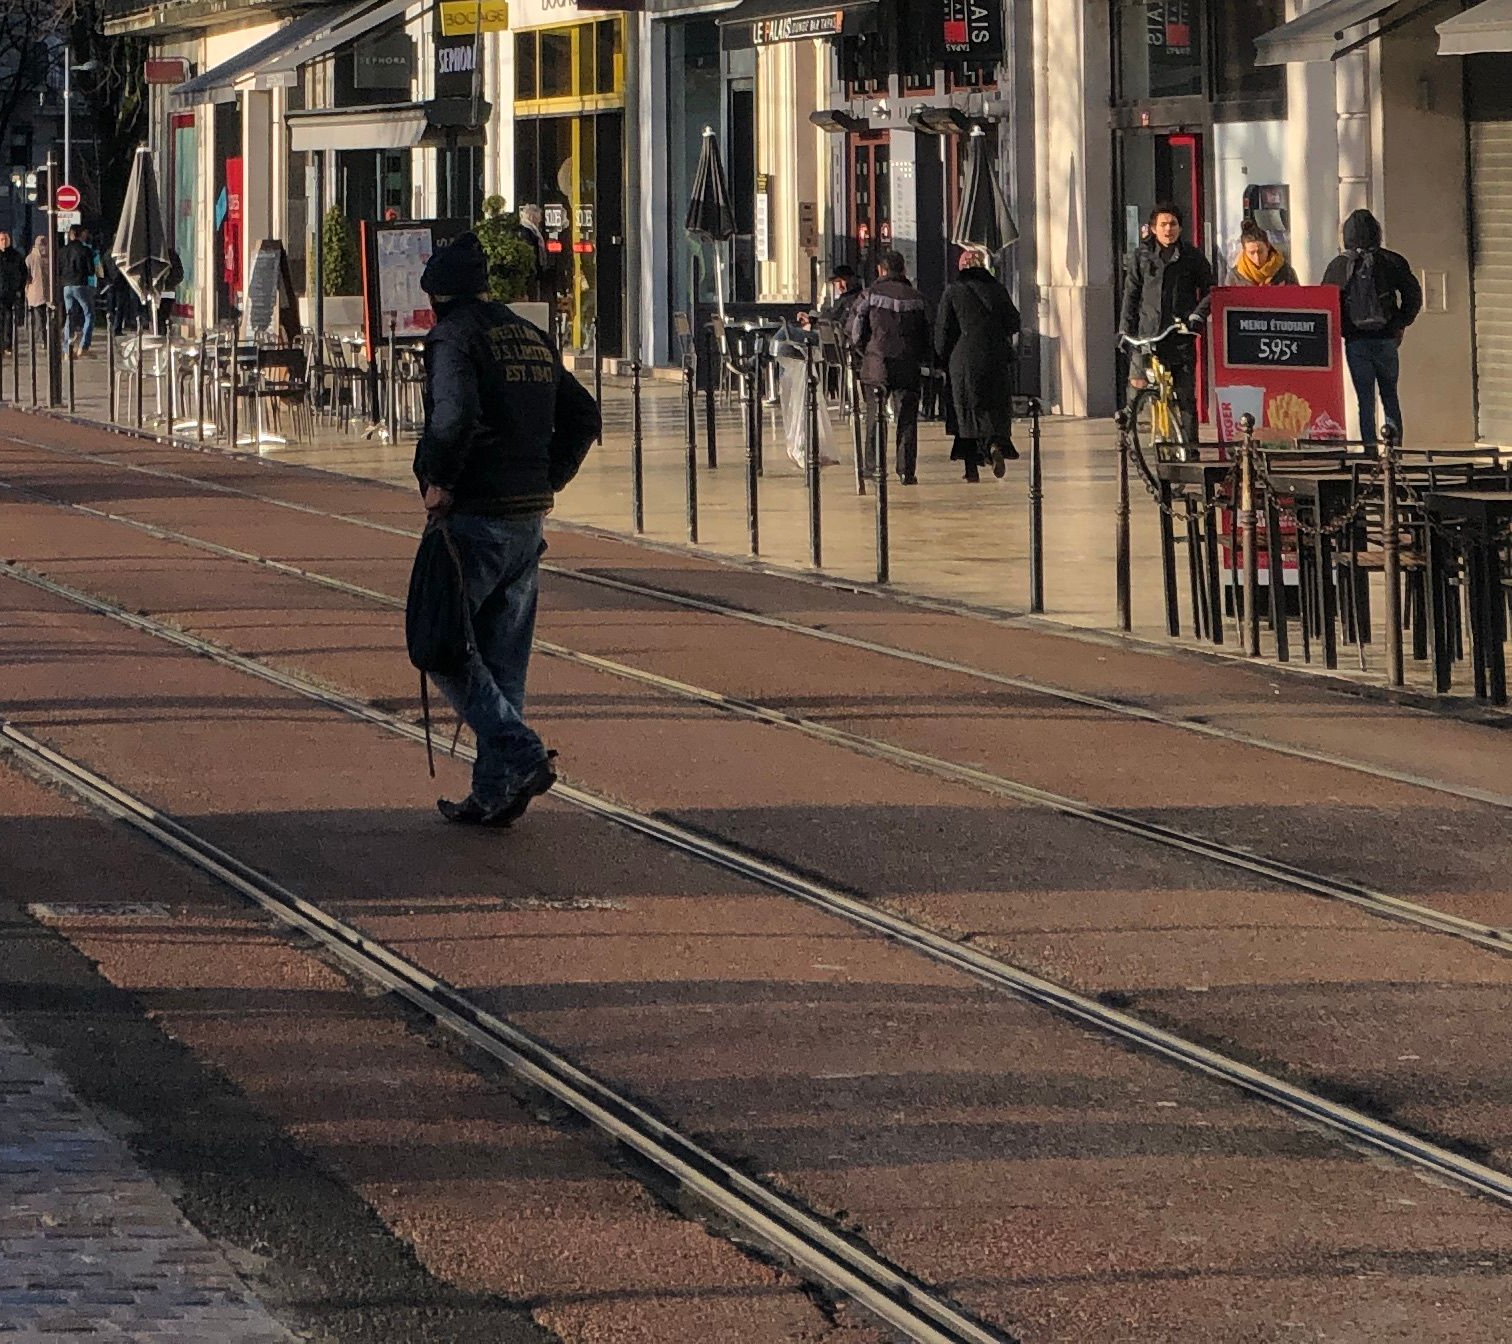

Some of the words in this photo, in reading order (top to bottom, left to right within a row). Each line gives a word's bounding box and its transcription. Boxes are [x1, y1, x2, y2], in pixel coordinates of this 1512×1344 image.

[753, 22, 764, 44] LE
[765, 17, 792, 42] PALAIS
[1240, 319, 1268, 330] MENU
